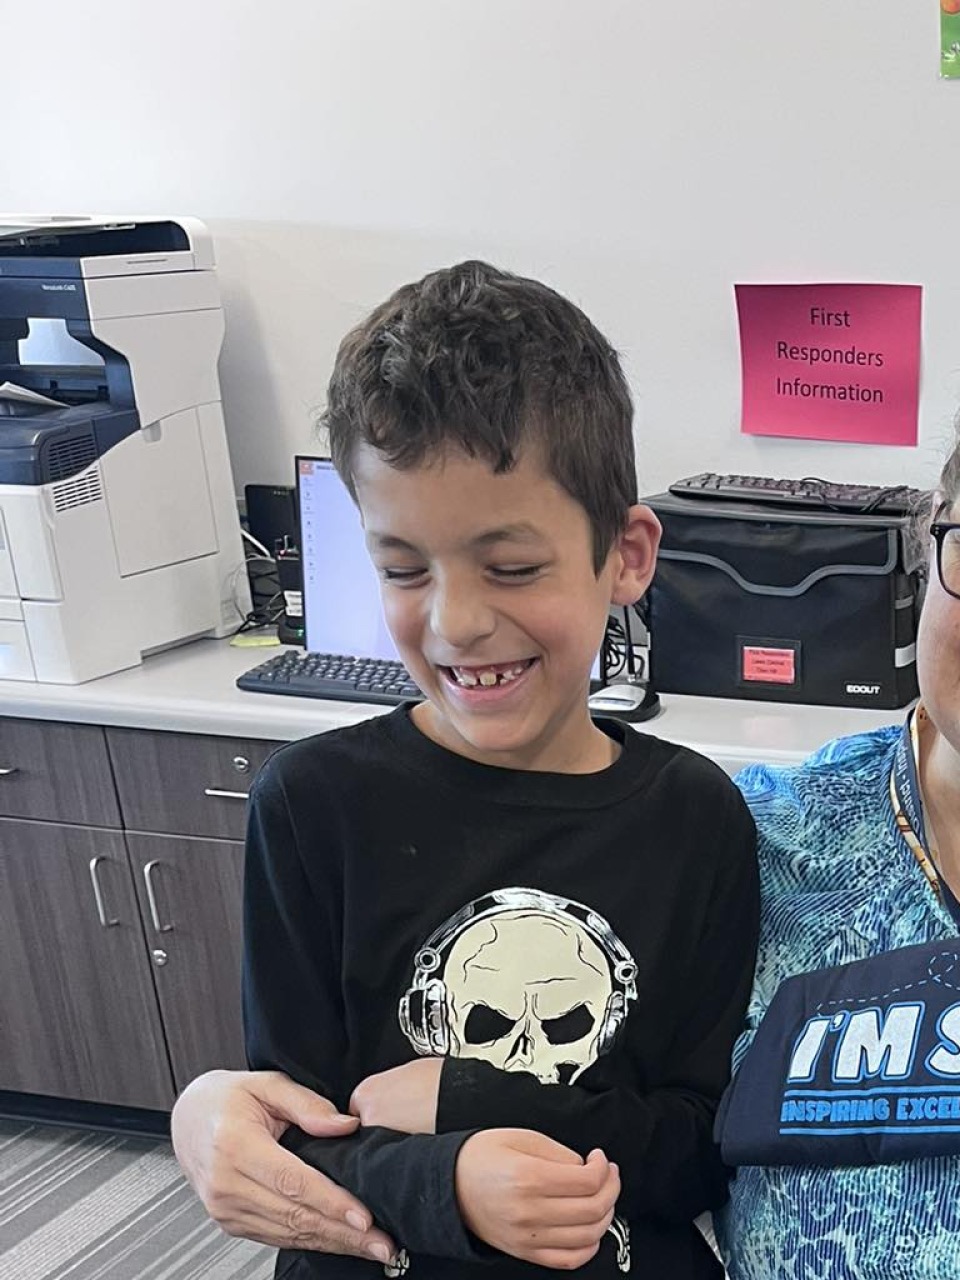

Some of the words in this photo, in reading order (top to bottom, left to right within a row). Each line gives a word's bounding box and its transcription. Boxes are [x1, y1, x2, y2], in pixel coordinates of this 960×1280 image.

[809, 306, 851, 329] First
[776, 341, 884, 368] Responders
[775, 378, 884, 404] Information
[786, 1000, 926, 1083] I'M
[780, 1095, 890, 1123] INSPIRING
